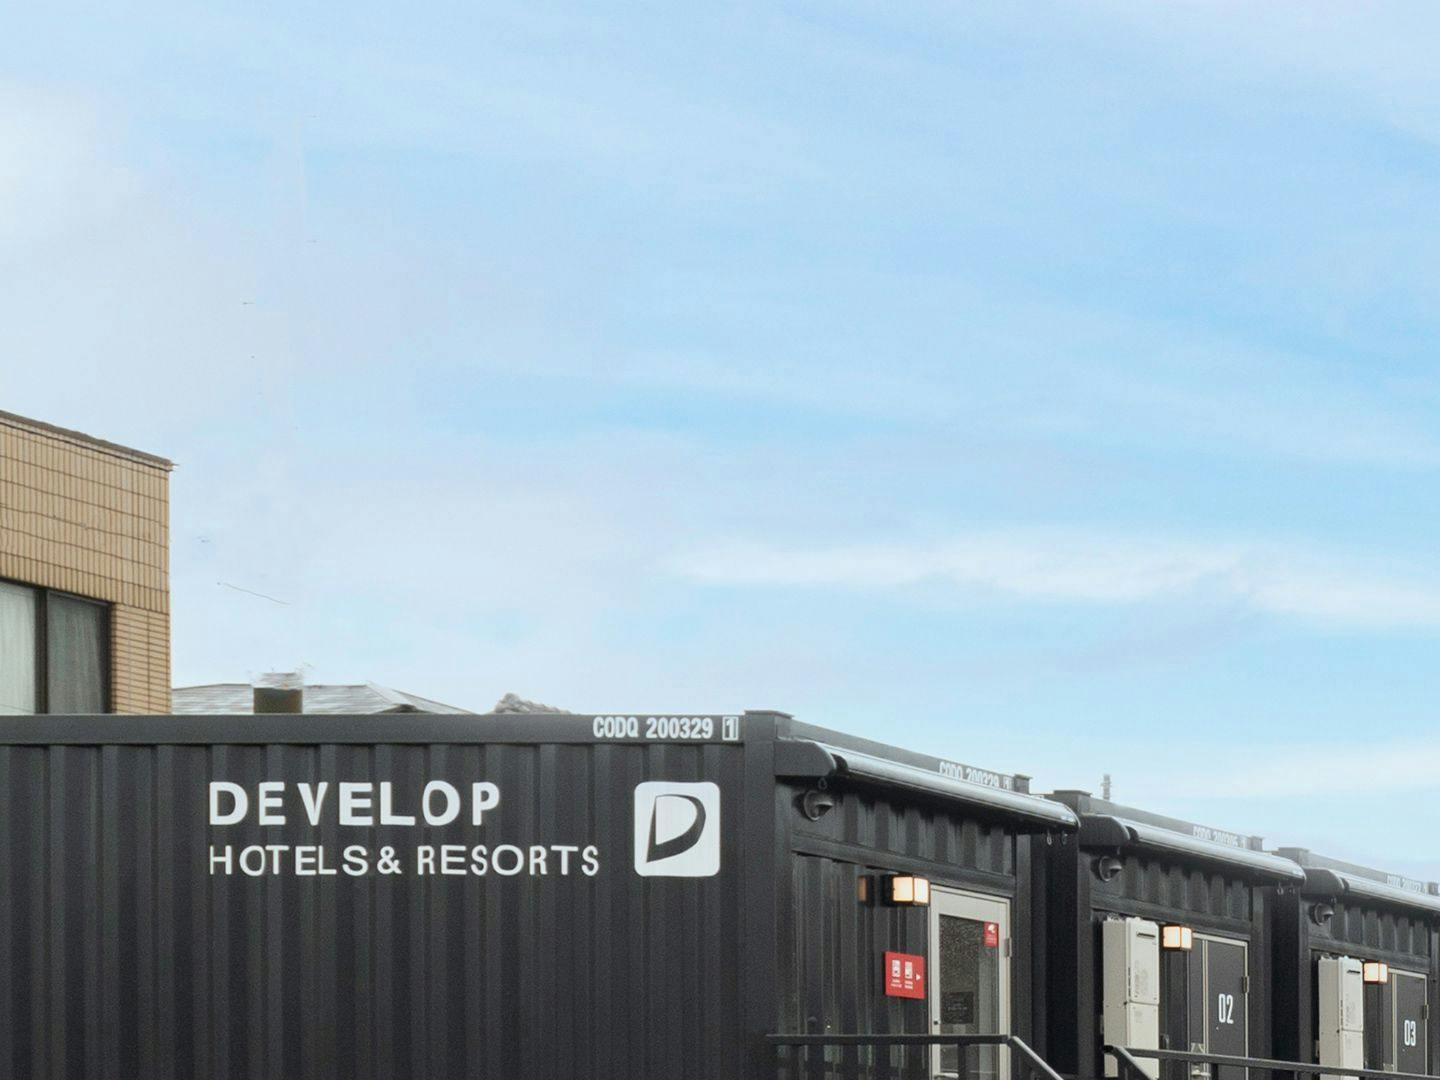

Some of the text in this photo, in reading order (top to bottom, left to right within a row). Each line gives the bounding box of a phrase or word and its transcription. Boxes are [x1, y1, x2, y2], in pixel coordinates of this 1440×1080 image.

[593, 716, 738, 740] CODQ 200329 1
[209, 780, 500, 826] DEVELOP
[417, 844, 599, 877] RESORTS
[1218, 993, 1234, 1025] 02
[1403, 1019, 1417, 1047] 03
